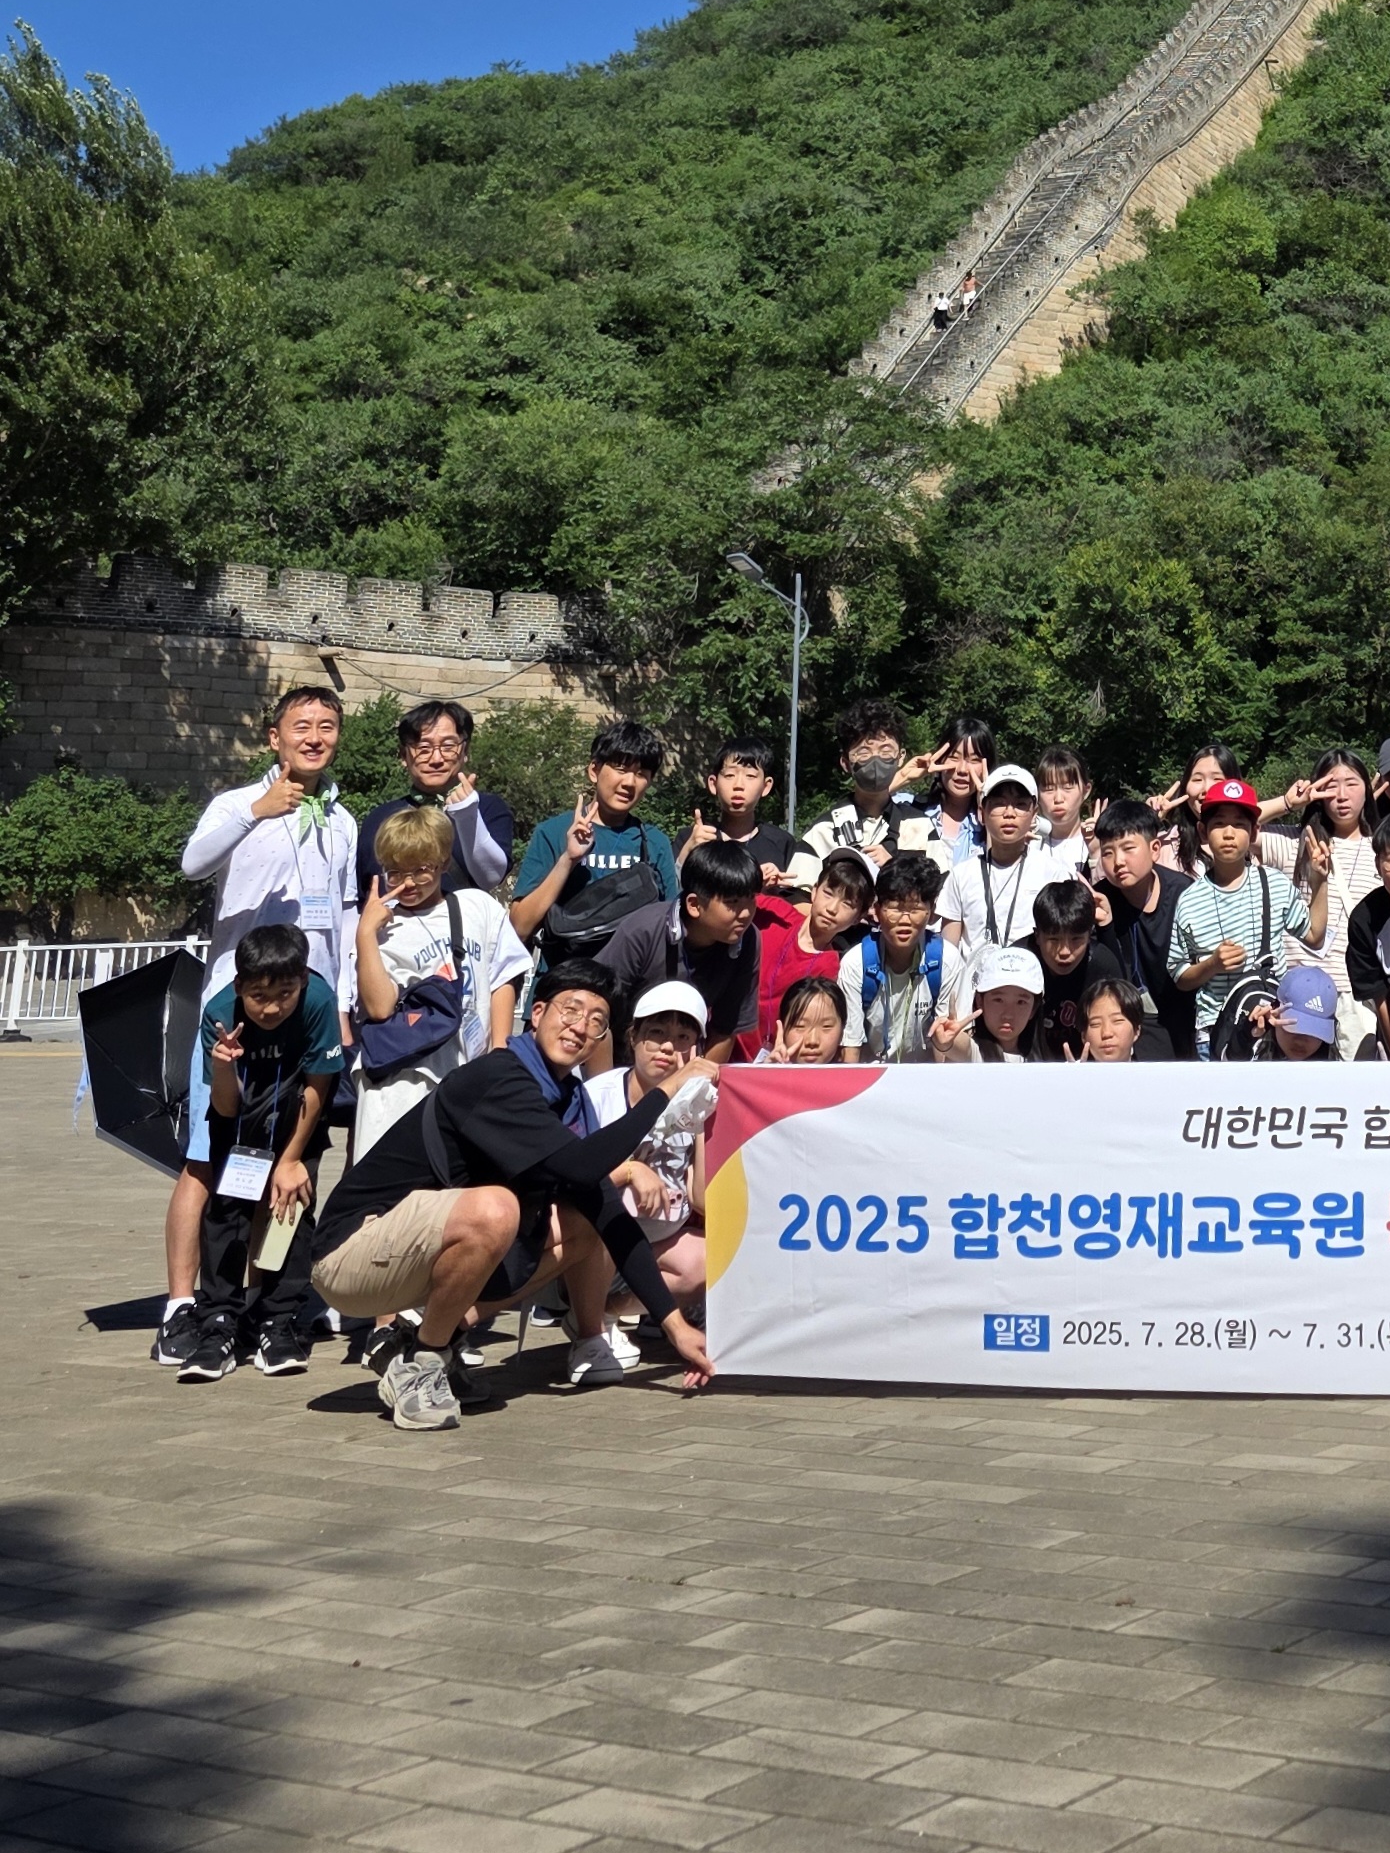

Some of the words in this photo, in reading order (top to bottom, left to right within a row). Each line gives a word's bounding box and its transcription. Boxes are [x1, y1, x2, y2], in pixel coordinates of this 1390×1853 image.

[1182, 1105, 1349, 1150] 대한민국
[777, 1192, 930, 1254] 2025
[947, 1190, 1366, 1261] 합천영재교육원
[993, 1316, 1041, 1347] 일정
[1062, 1320, 1130, 1348] 2025.
[1141, 1321, 1163, 1348] 7.
[1174, 1318, 1257, 1351] 28.(월)
[1302, 1322, 1325, 1350] 7.
